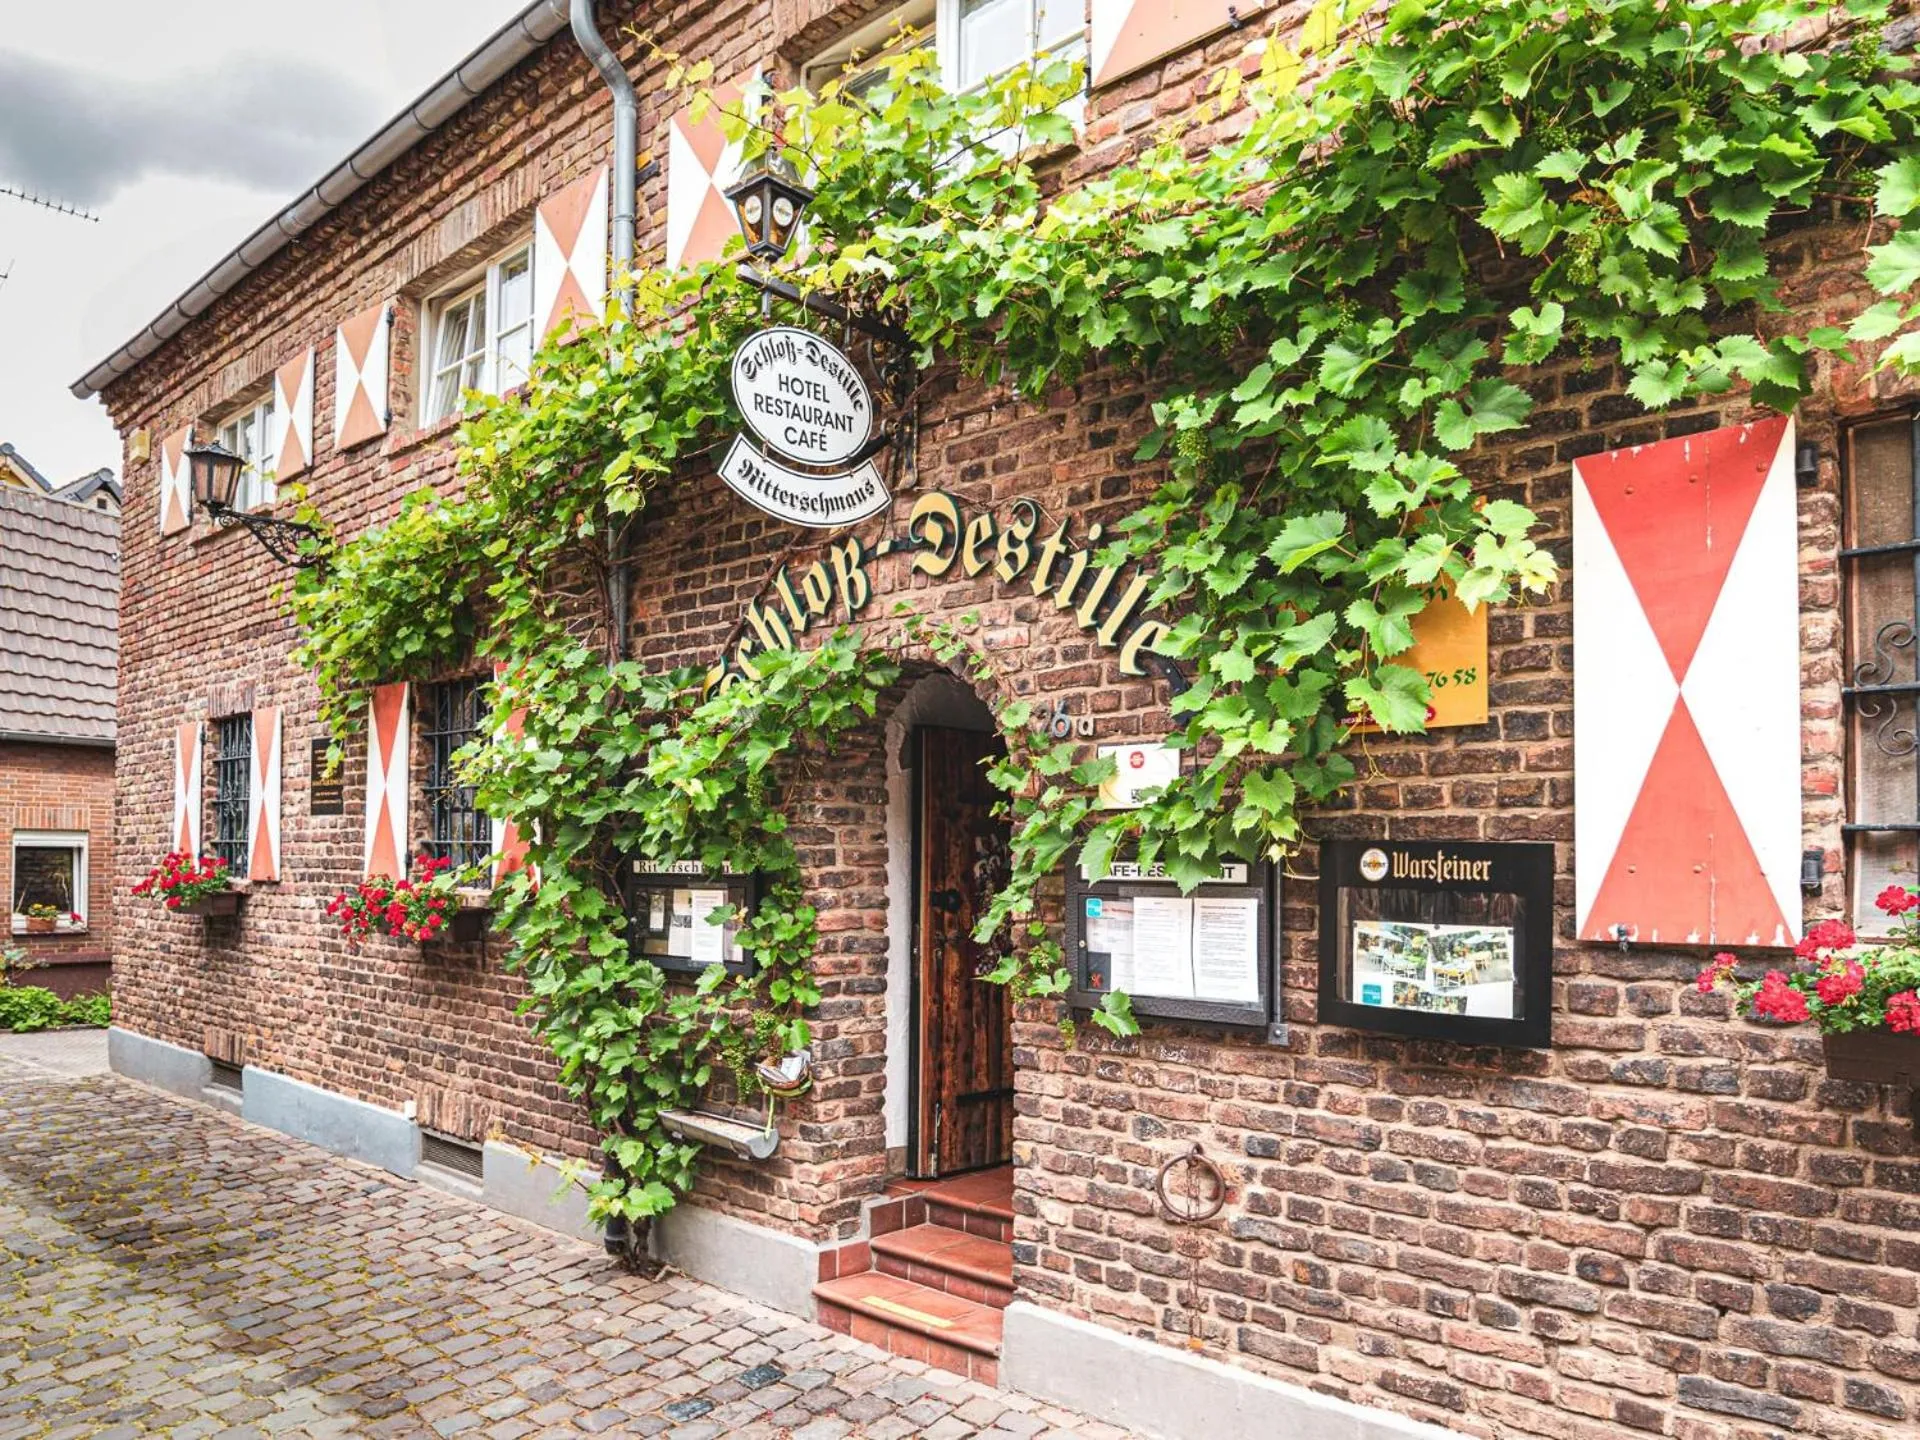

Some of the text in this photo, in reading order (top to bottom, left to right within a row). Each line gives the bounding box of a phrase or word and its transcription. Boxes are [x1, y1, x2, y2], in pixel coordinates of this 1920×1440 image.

[778, 373, 830, 404] HOTEL
[754, 393, 855, 433] RESTAURANT
[784, 429, 828, 451] CAFÉ
[737, 458, 875, 519] Ritterschmaus
[1392, 850, 1492, 883] Warsteiner
